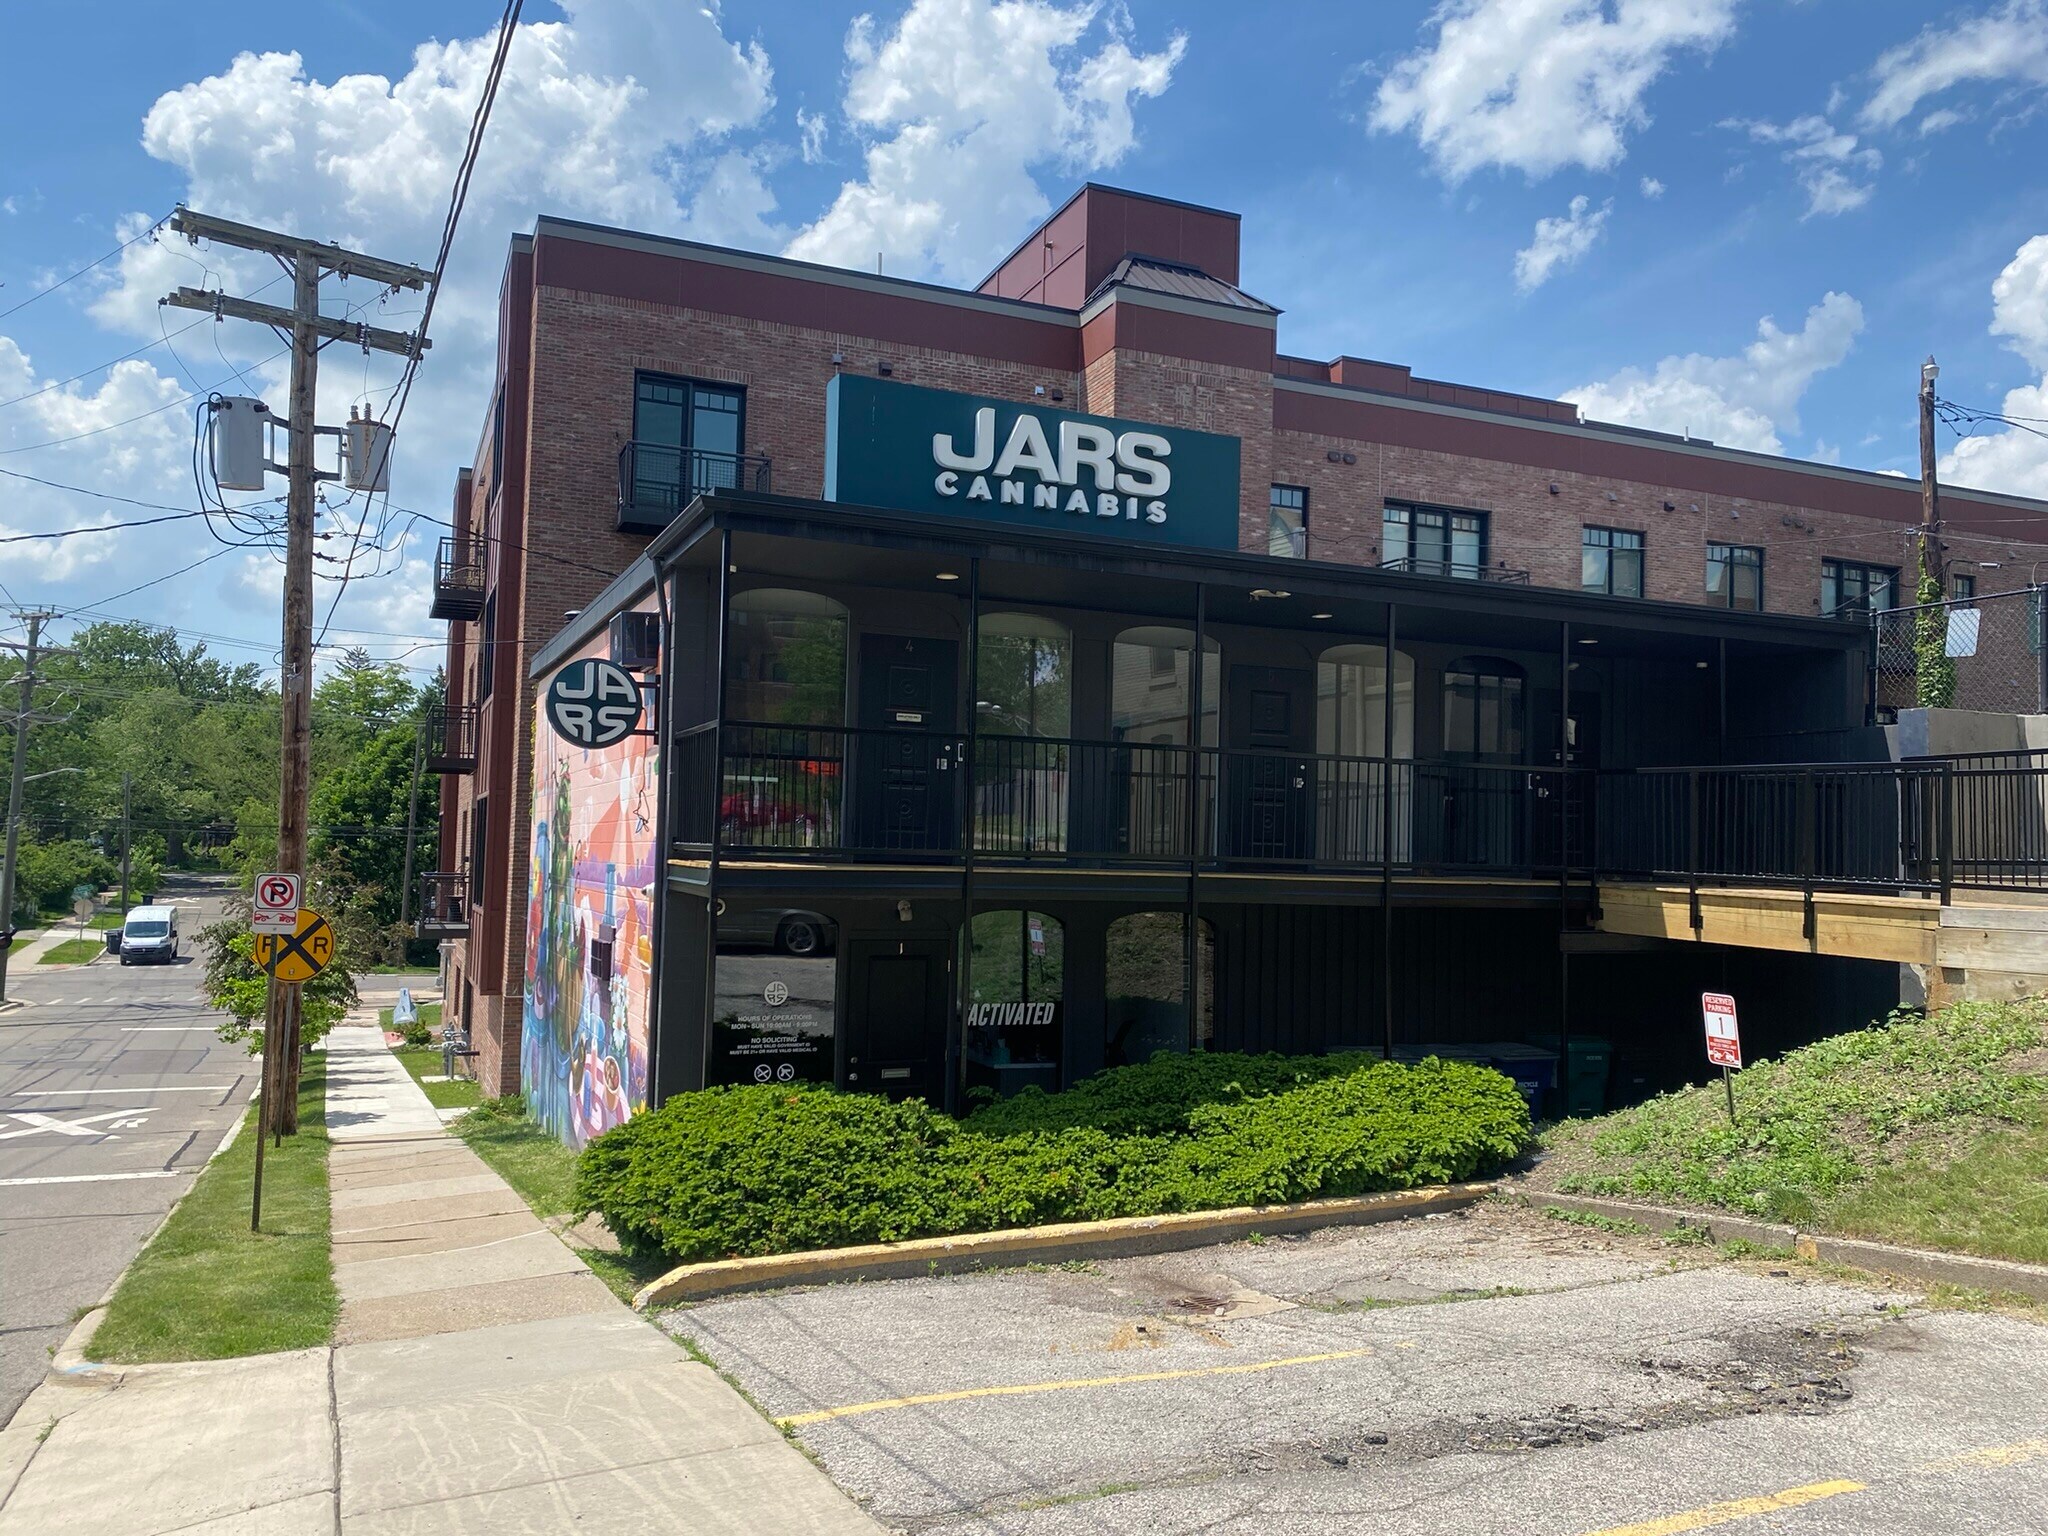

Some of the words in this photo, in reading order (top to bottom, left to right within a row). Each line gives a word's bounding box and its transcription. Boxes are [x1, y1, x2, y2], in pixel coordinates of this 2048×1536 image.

[933, 407, 1172, 497] JARS
[934, 471, 1167, 523] CANNABIS
[905, 640, 914, 652] 4
[313, 936, 328, 955] R
[1705, 995, 1733, 1006] RESERVED
[1707, 1003, 1732, 1014] PARKING
[967, 1002, 1055, 1026] ACTIVATED
[1718, 1017, 1723, 1035] 1
